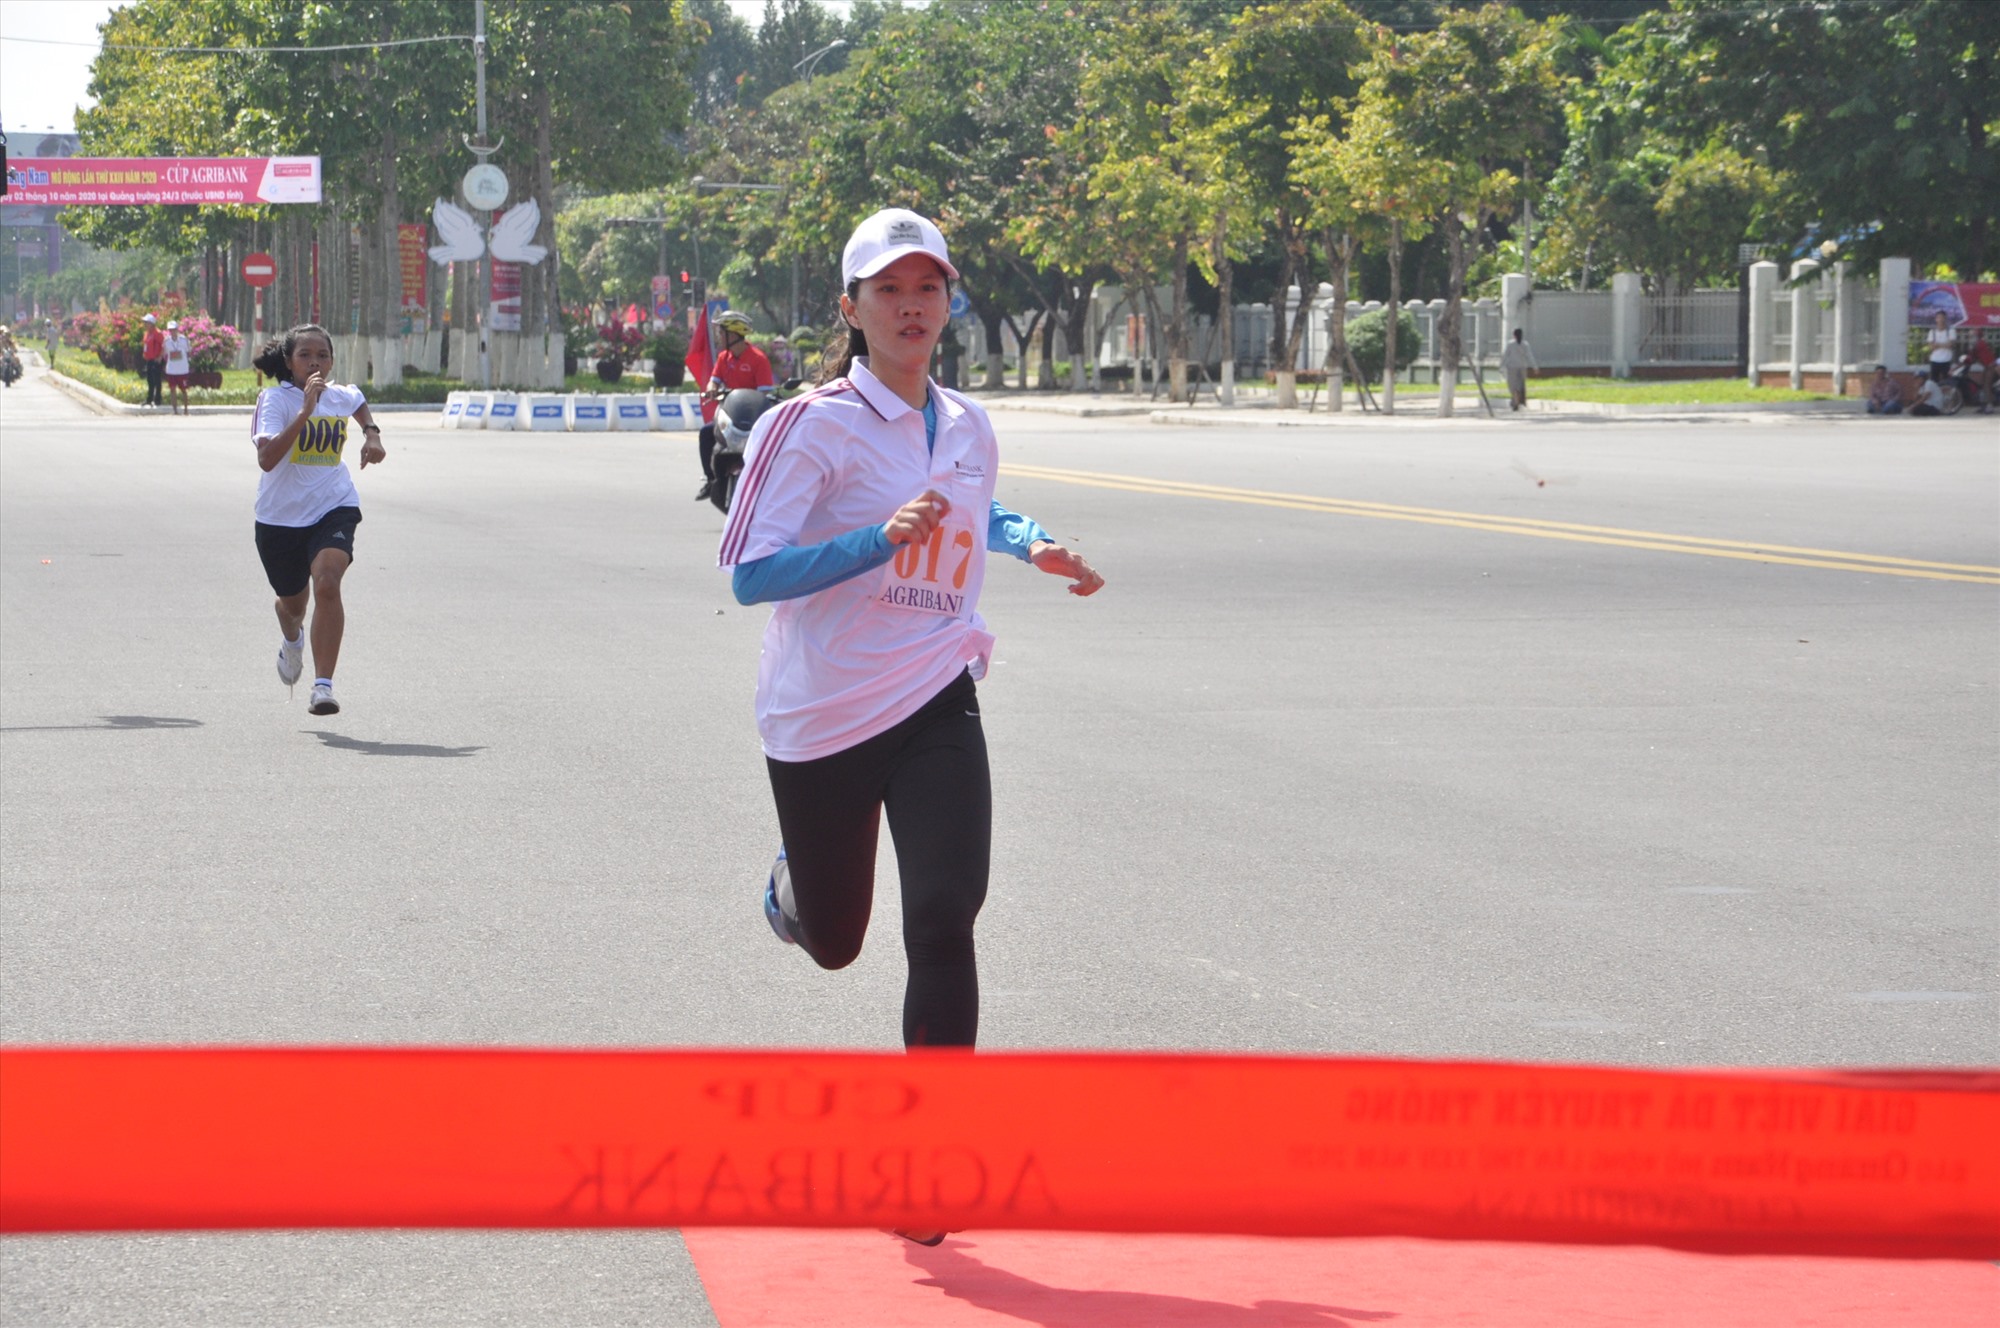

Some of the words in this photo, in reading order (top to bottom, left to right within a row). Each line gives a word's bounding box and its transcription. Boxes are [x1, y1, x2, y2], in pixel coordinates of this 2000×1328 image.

[27, 167, 48, 185] Nam
[142, 171, 157, 184] 2020
[166, 162, 189, 184] CÚP
[190, 165, 248, 183] AGRIBANK
[14, 191, 24, 201] 02
[25, 190, 47, 204] tháng
[50, 191, 59, 201] 10
[60, 191, 77, 201] năm
[79, 191, 97, 201] 2020
[98, 191, 108, 203] tại
[110, 190, 135, 203] Quảng
[136, 190, 160, 204] trường
[161, 190, 180, 201] 24/3
[204, 190, 226, 201] UBND
[298, 418, 346, 454] 006
[894, 526, 974, 590] 017
